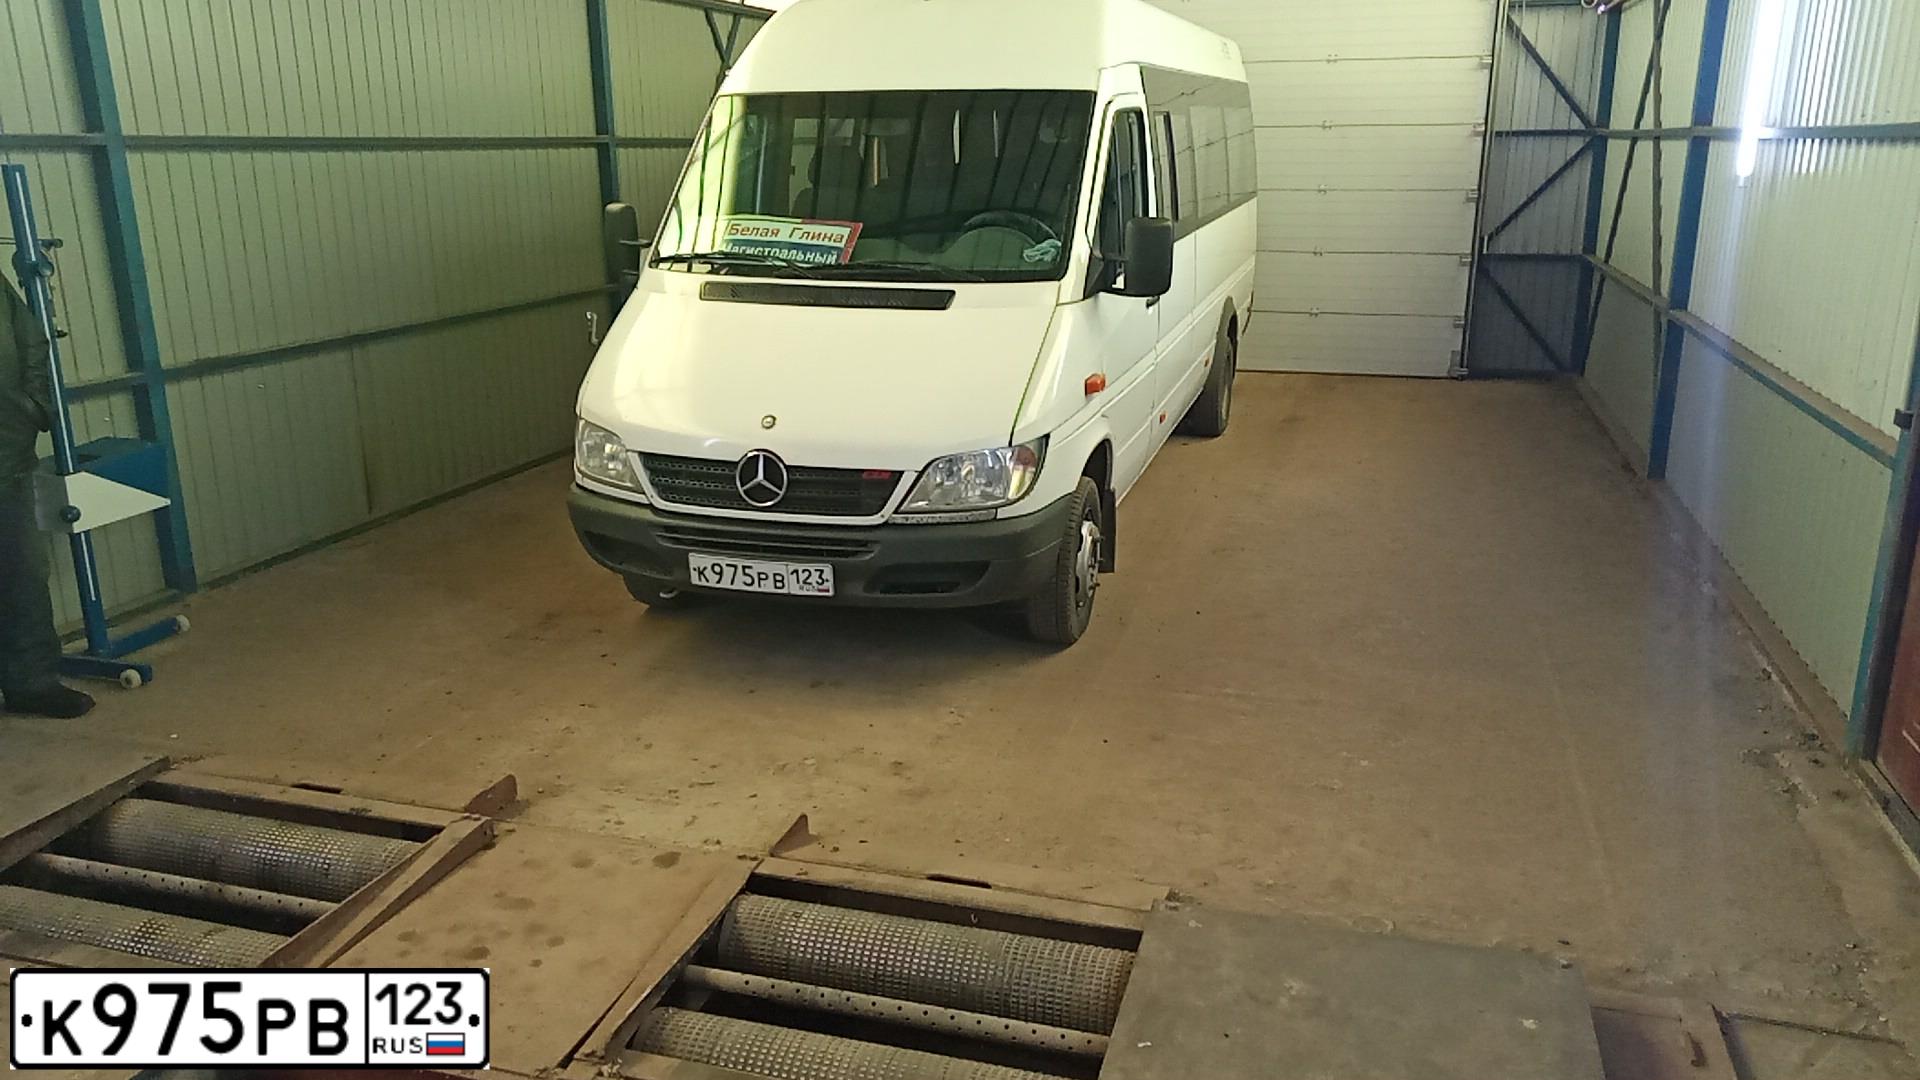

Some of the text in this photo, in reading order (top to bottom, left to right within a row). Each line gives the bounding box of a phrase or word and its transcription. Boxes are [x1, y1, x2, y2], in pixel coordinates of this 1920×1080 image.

[728, 223, 845, 243] Белая Глина
[790, 568, 825, 586] 123
